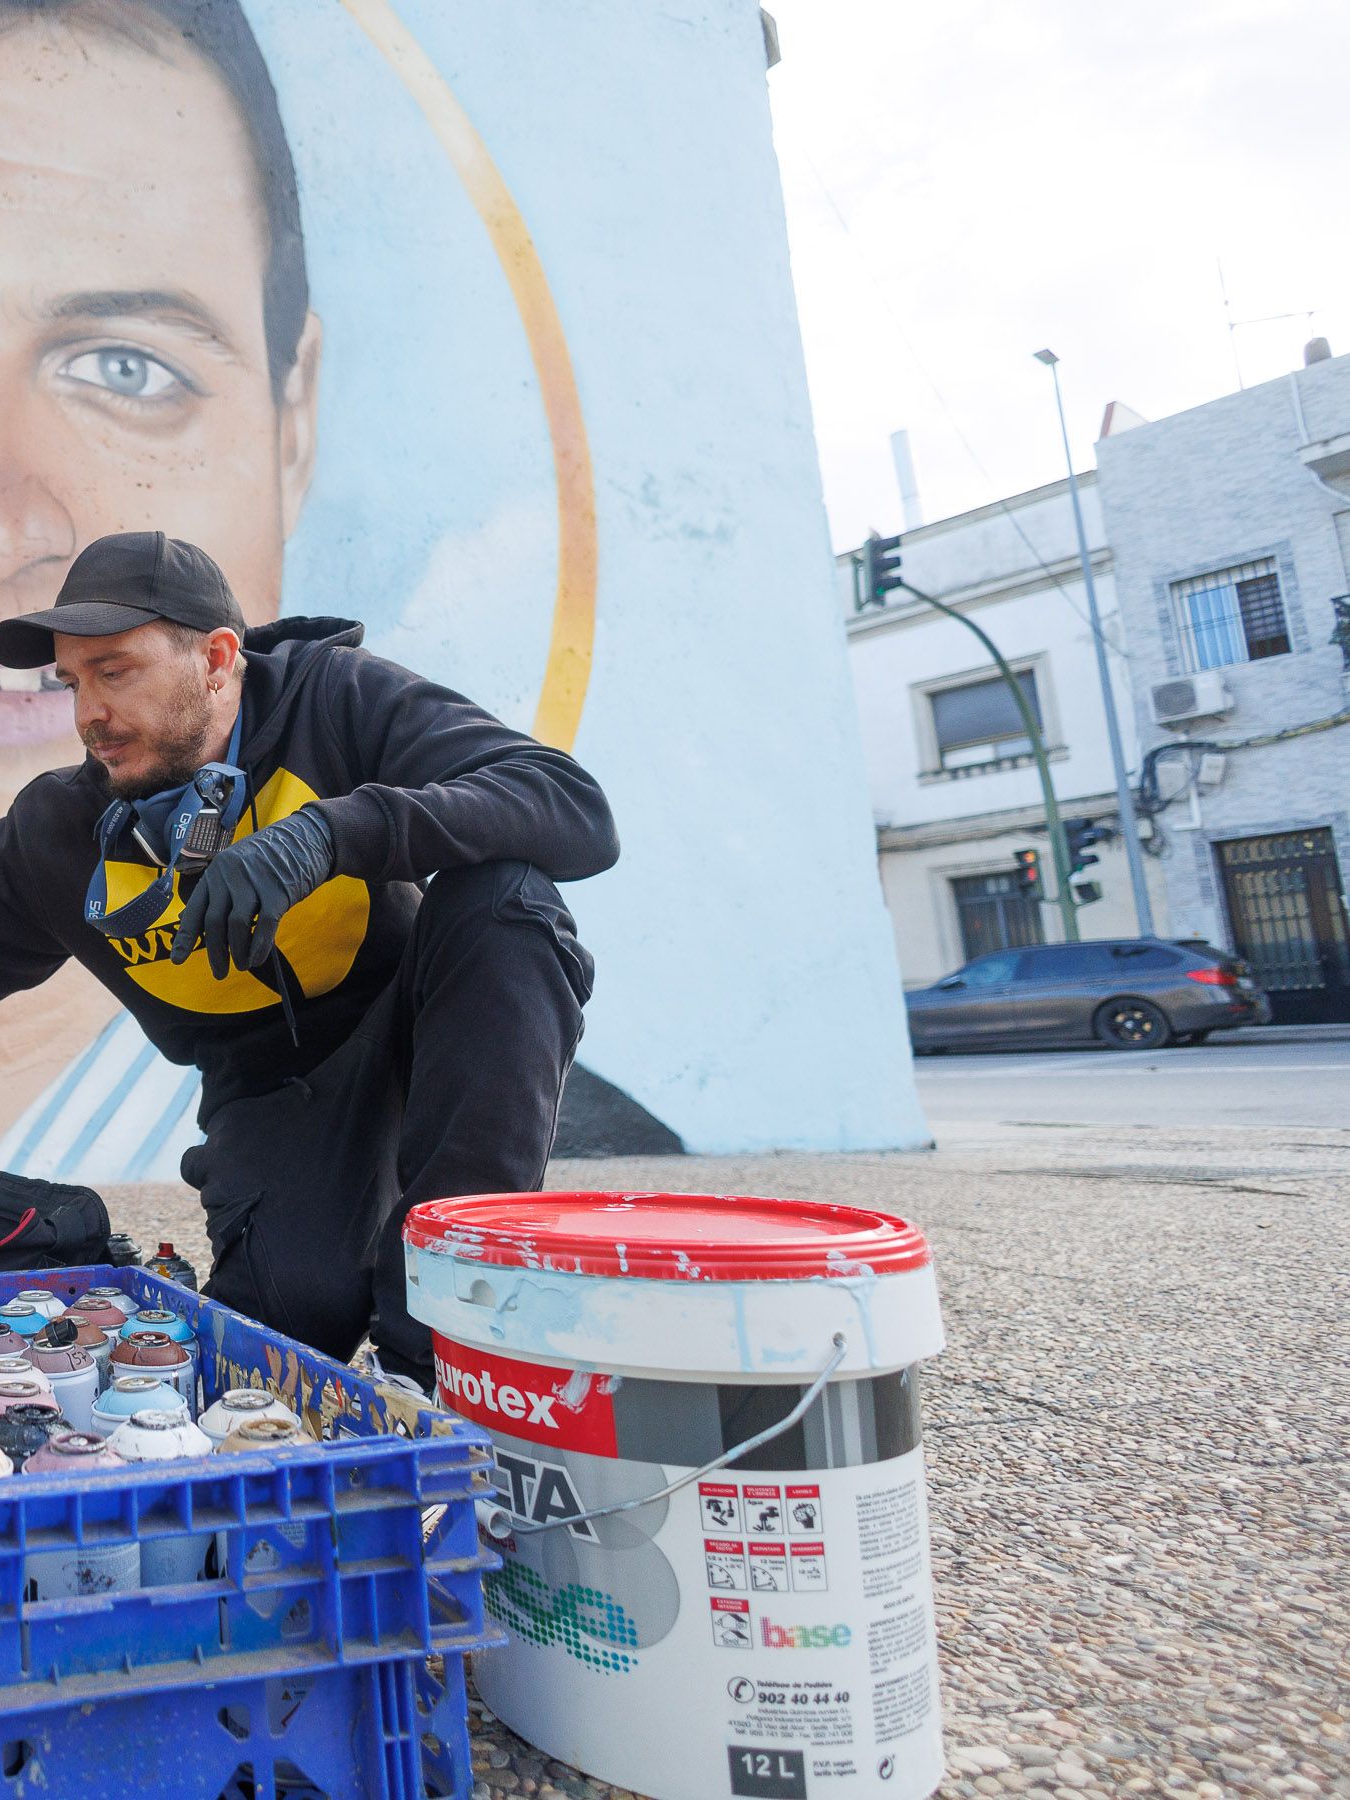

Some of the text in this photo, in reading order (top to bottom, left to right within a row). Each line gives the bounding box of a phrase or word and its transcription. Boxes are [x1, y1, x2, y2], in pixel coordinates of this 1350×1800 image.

[175, 813, 191, 839] GVS
[760, 1616, 852, 1649] base
[758, 1691, 850, 1704] 902 40 44 40
[741, 1752, 795, 1779] 12 L
